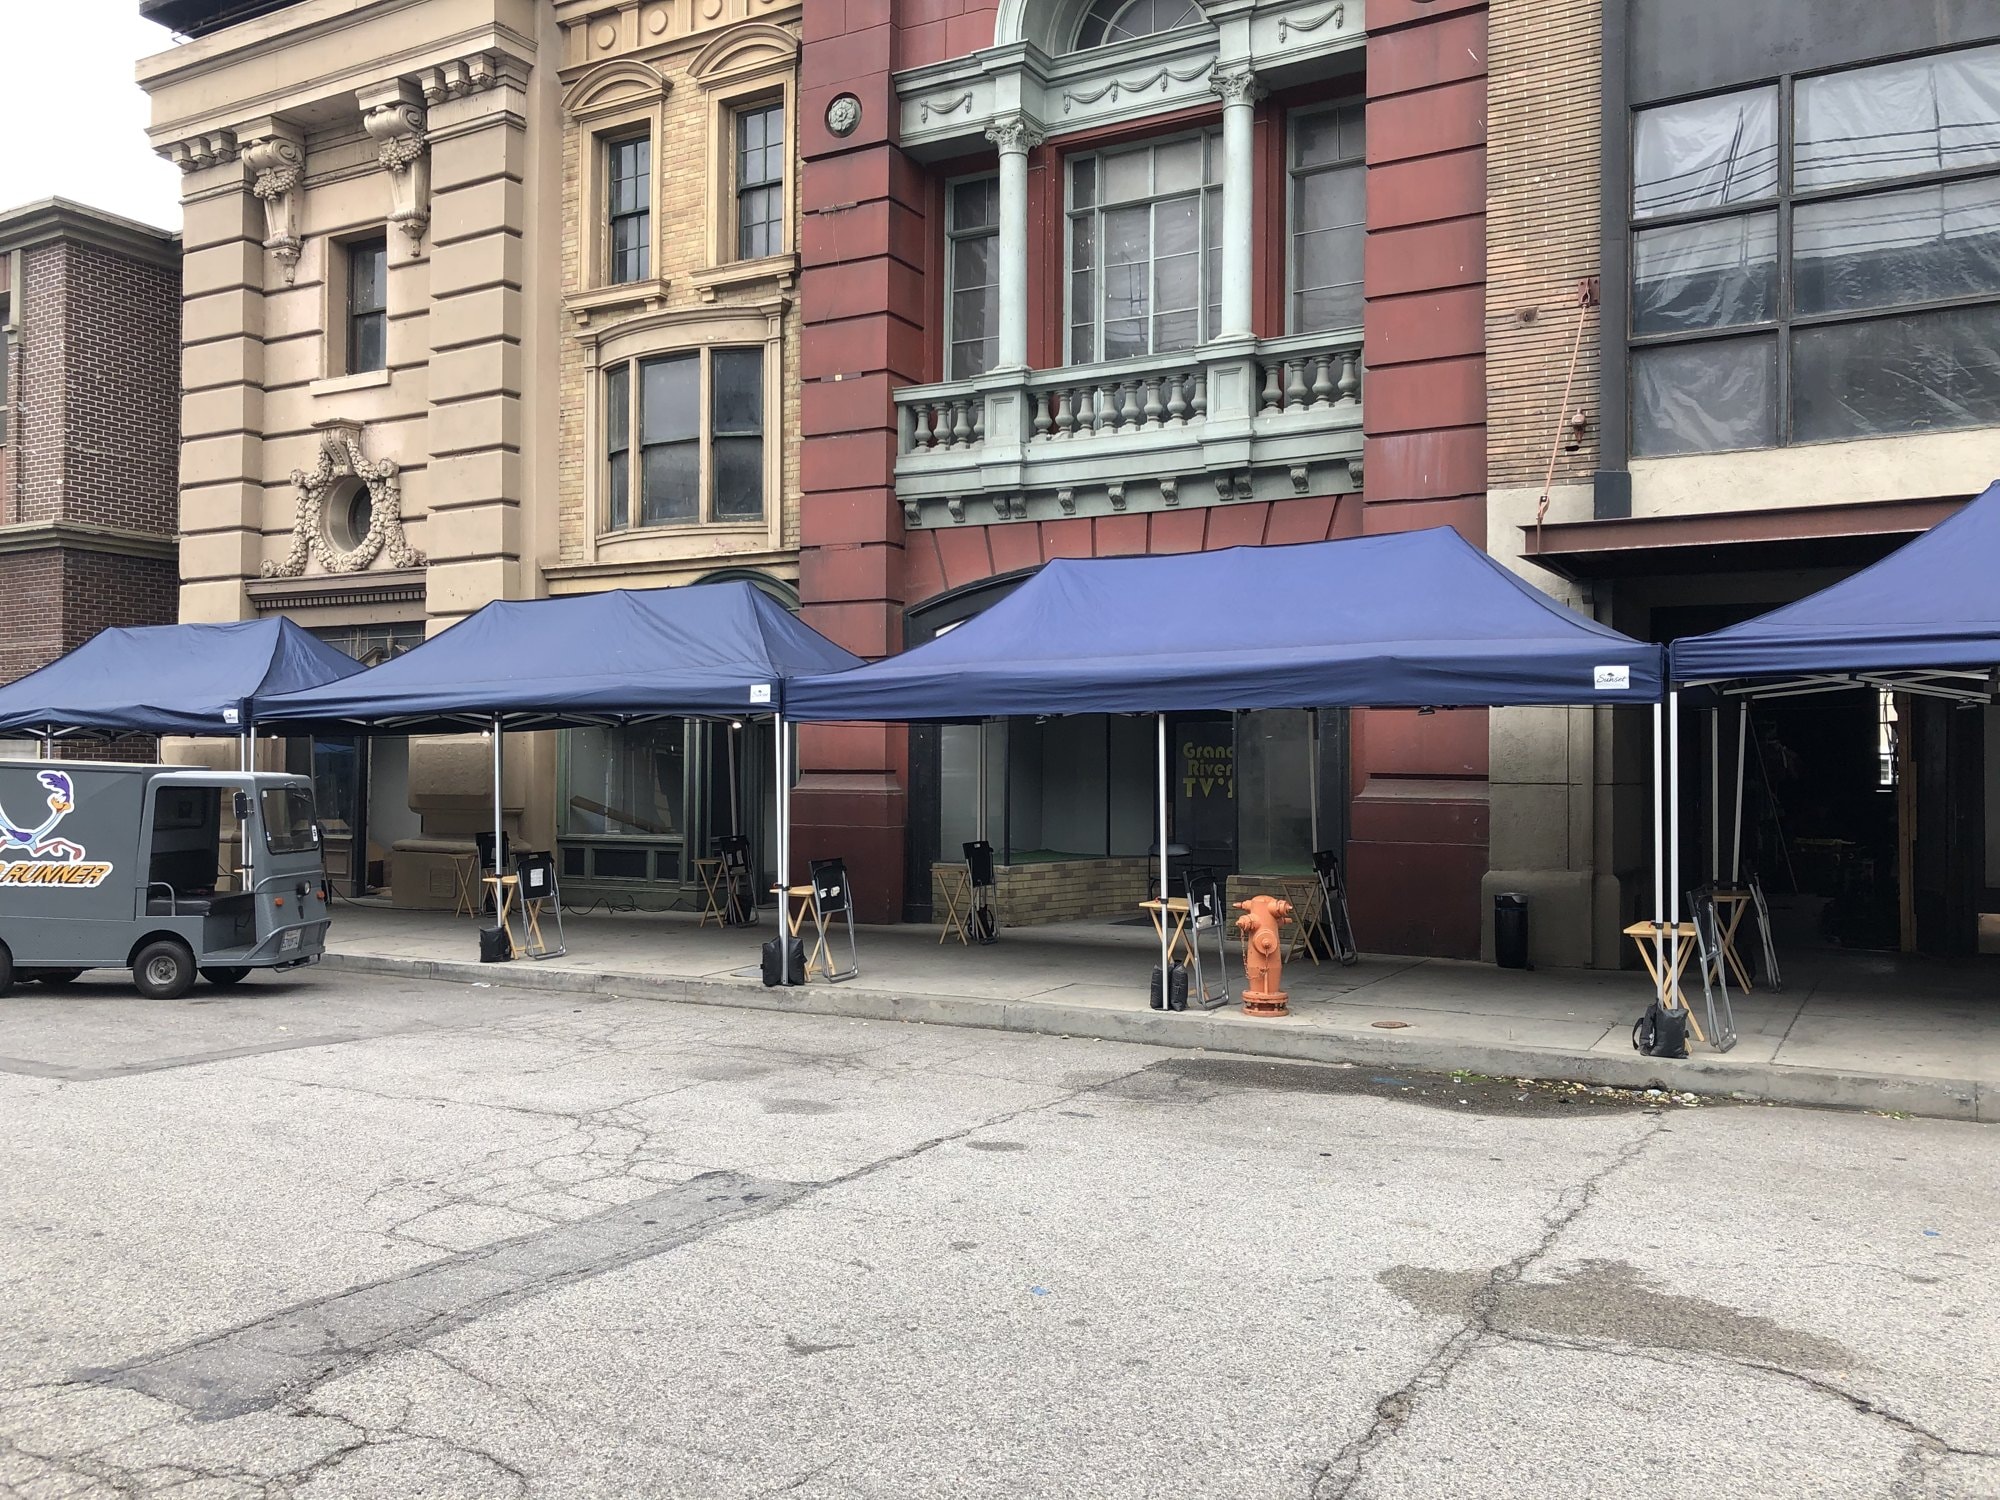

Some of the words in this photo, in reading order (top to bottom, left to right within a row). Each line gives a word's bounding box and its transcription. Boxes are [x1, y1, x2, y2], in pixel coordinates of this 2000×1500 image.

[1596, 673, 1626, 683] Sunset
[1187, 759, 1233, 776] River
[1, 864, 110, 884] RUNNER
